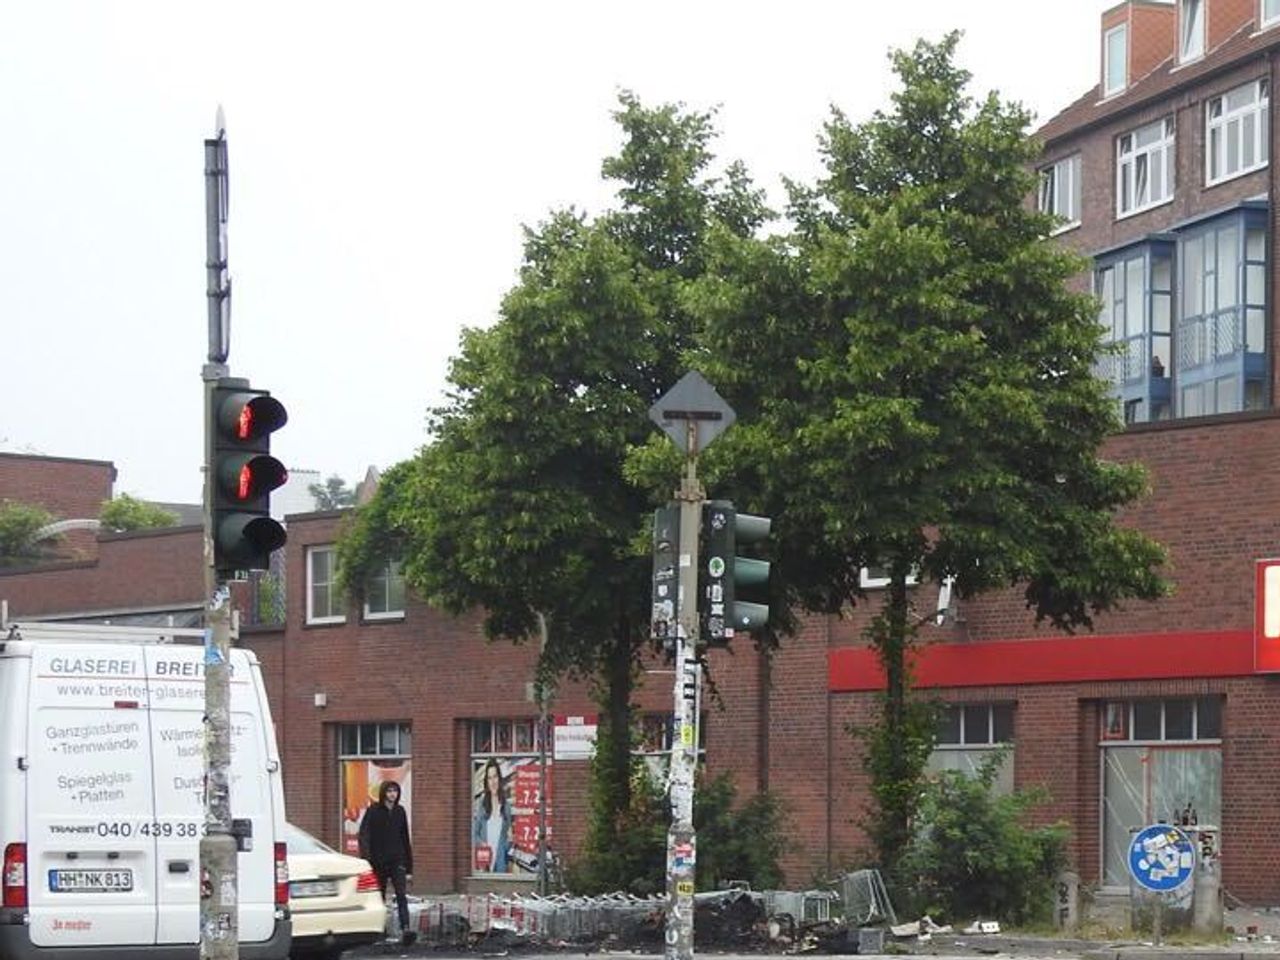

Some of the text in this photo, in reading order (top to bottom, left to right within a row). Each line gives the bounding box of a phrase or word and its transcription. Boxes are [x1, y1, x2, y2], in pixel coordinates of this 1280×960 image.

[50, 658, 136, 675] GLASEREI
[58, 771, 133, 790] Spiegelglas
[177, 823, 197, 837] 38
[58, 872, 130, 886] HH NK 813
